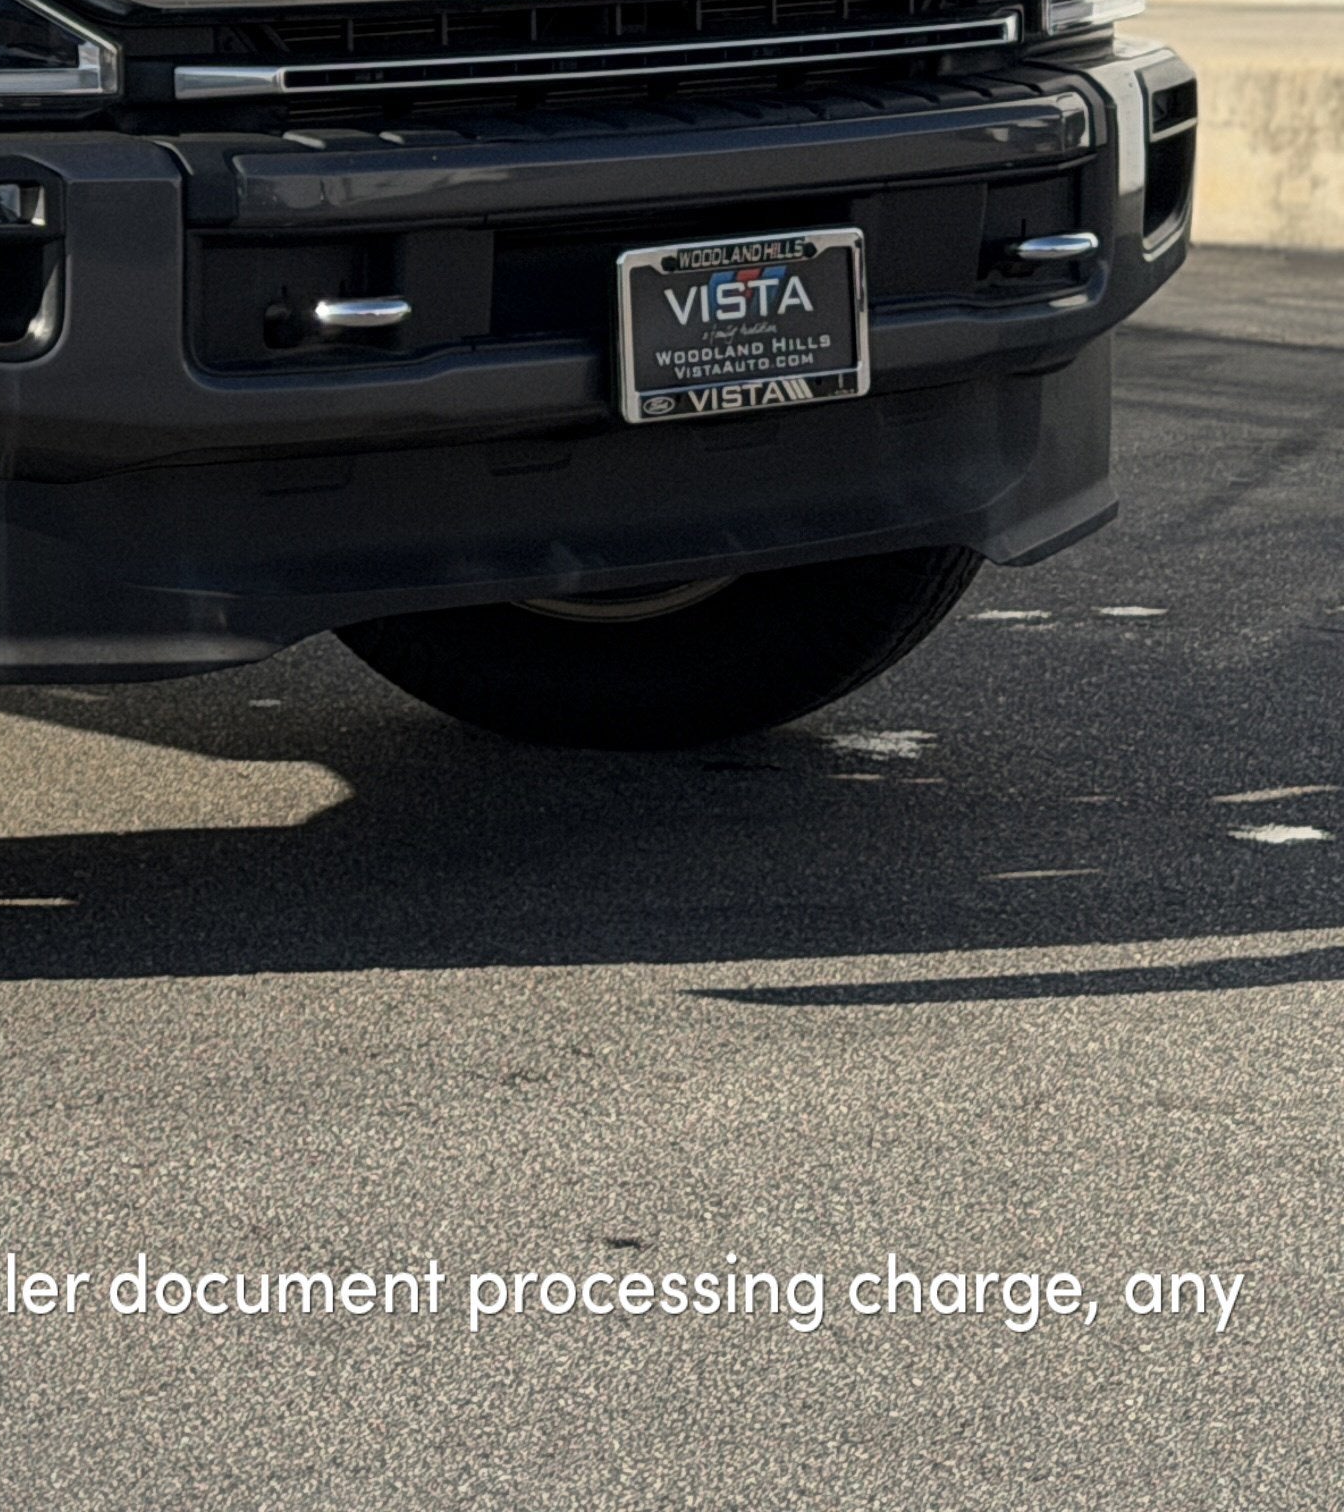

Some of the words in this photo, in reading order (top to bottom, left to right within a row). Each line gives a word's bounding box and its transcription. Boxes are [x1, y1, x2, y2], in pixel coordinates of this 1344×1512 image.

[678, 243, 762, 269] WOODLAND
[763, 239, 805, 260] HILLS
[663, 275, 815, 326] VISTA
[655, 341, 764, 367] WOODLAND
[771, 334, 832, 354] HILLS
[687, 380, 786, 412] VISTA
